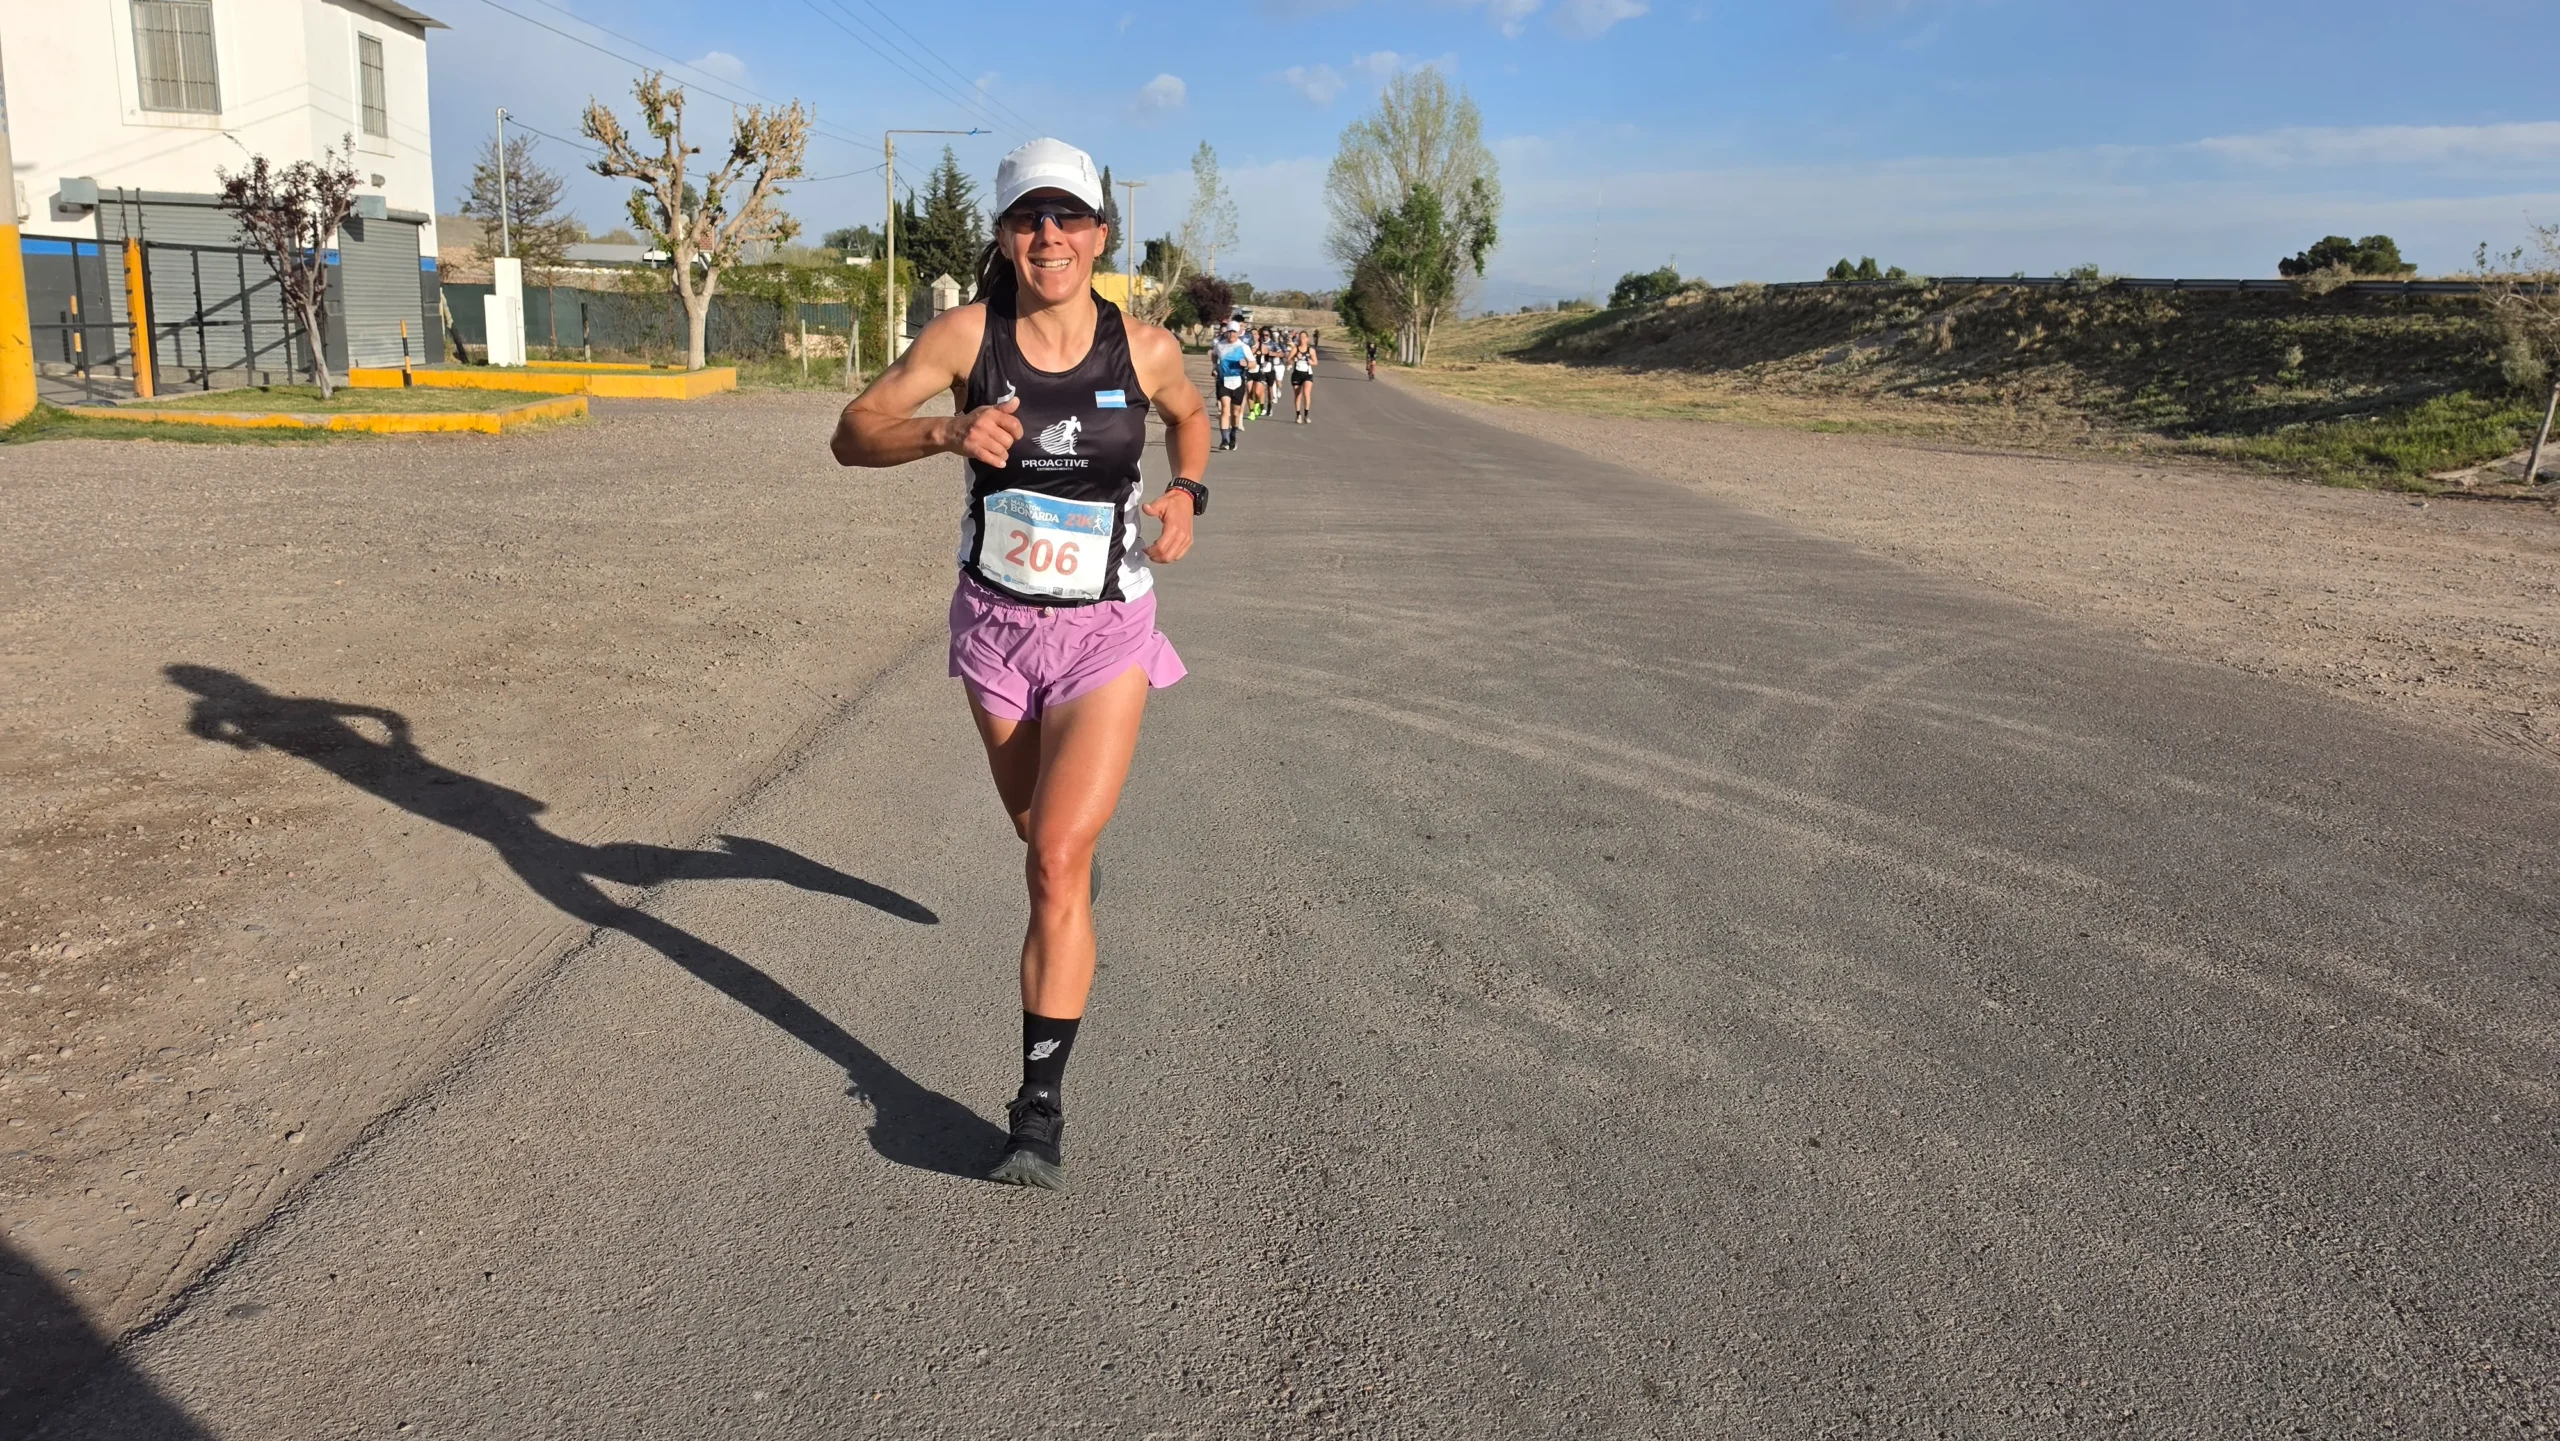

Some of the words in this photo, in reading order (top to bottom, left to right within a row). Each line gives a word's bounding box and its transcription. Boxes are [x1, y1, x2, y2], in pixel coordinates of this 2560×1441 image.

[1021, 459, 1089, 468] PROACTIVE
[1010, 503, 1060, 523] BONARDA
[1065, 513, 1092, 529] 21K
[1004, 529, 1080, 576] 206
